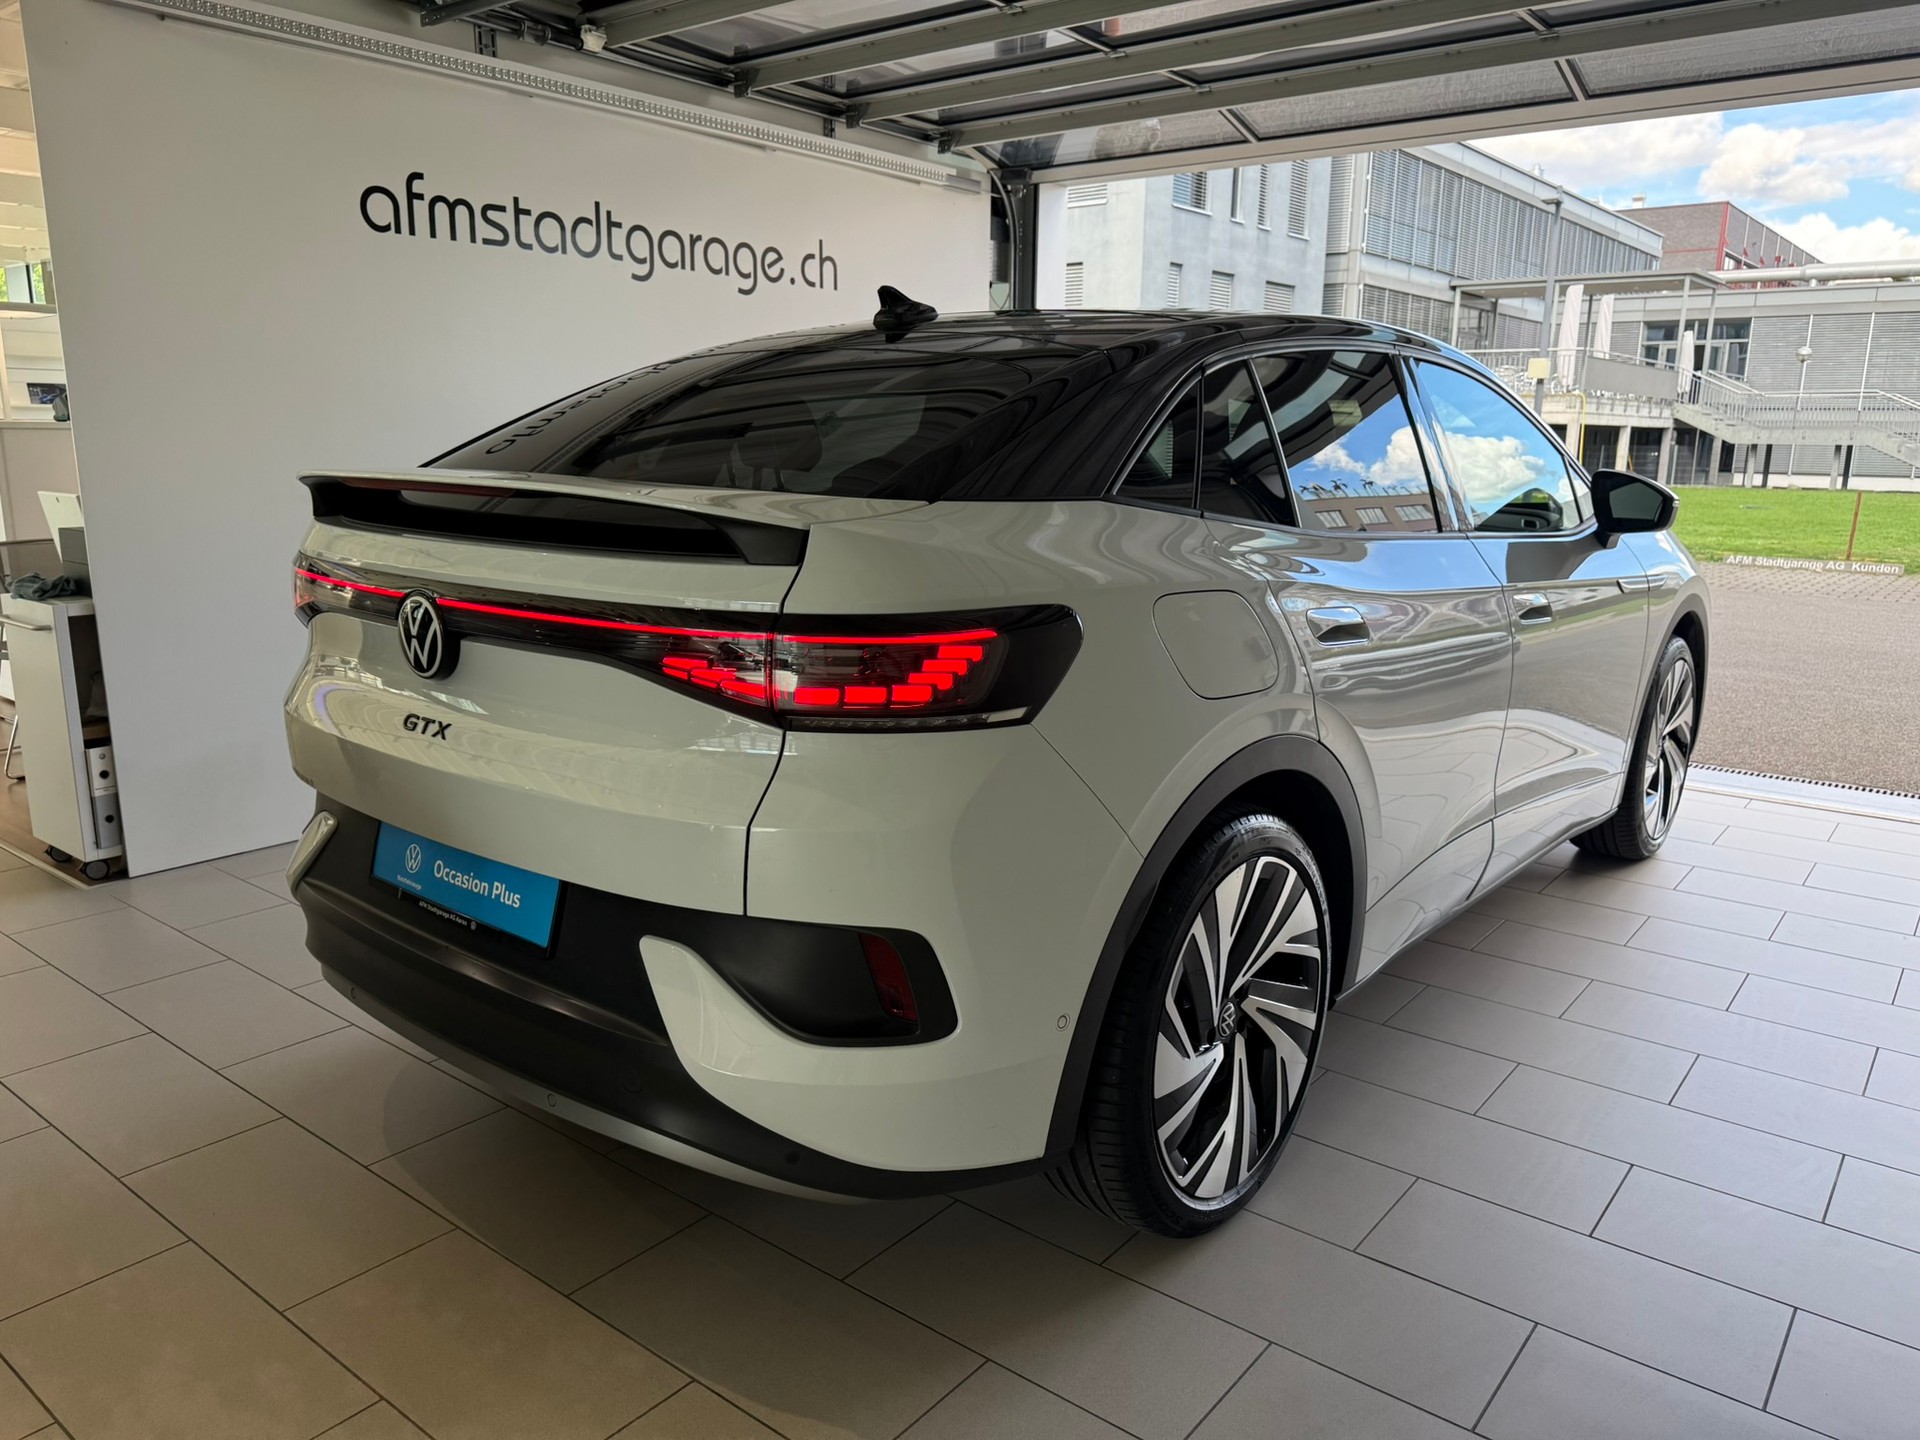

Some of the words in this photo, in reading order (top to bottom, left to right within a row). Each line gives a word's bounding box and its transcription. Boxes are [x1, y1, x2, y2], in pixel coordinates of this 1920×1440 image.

[359, 171, 838, 295] afmstadtgarage.ch
[1726, 555, 1753, 565] AFM
[1755, 556, 1824, 570] Stadtgarage
[1826, 560, 1845, 570] AG
[1851, 562, 1899, 573] Kunden
[402, 713, 452, 741] GTX
[434, 860, 488, 896] Occasion
[492, 881, 521, 908] Plus
